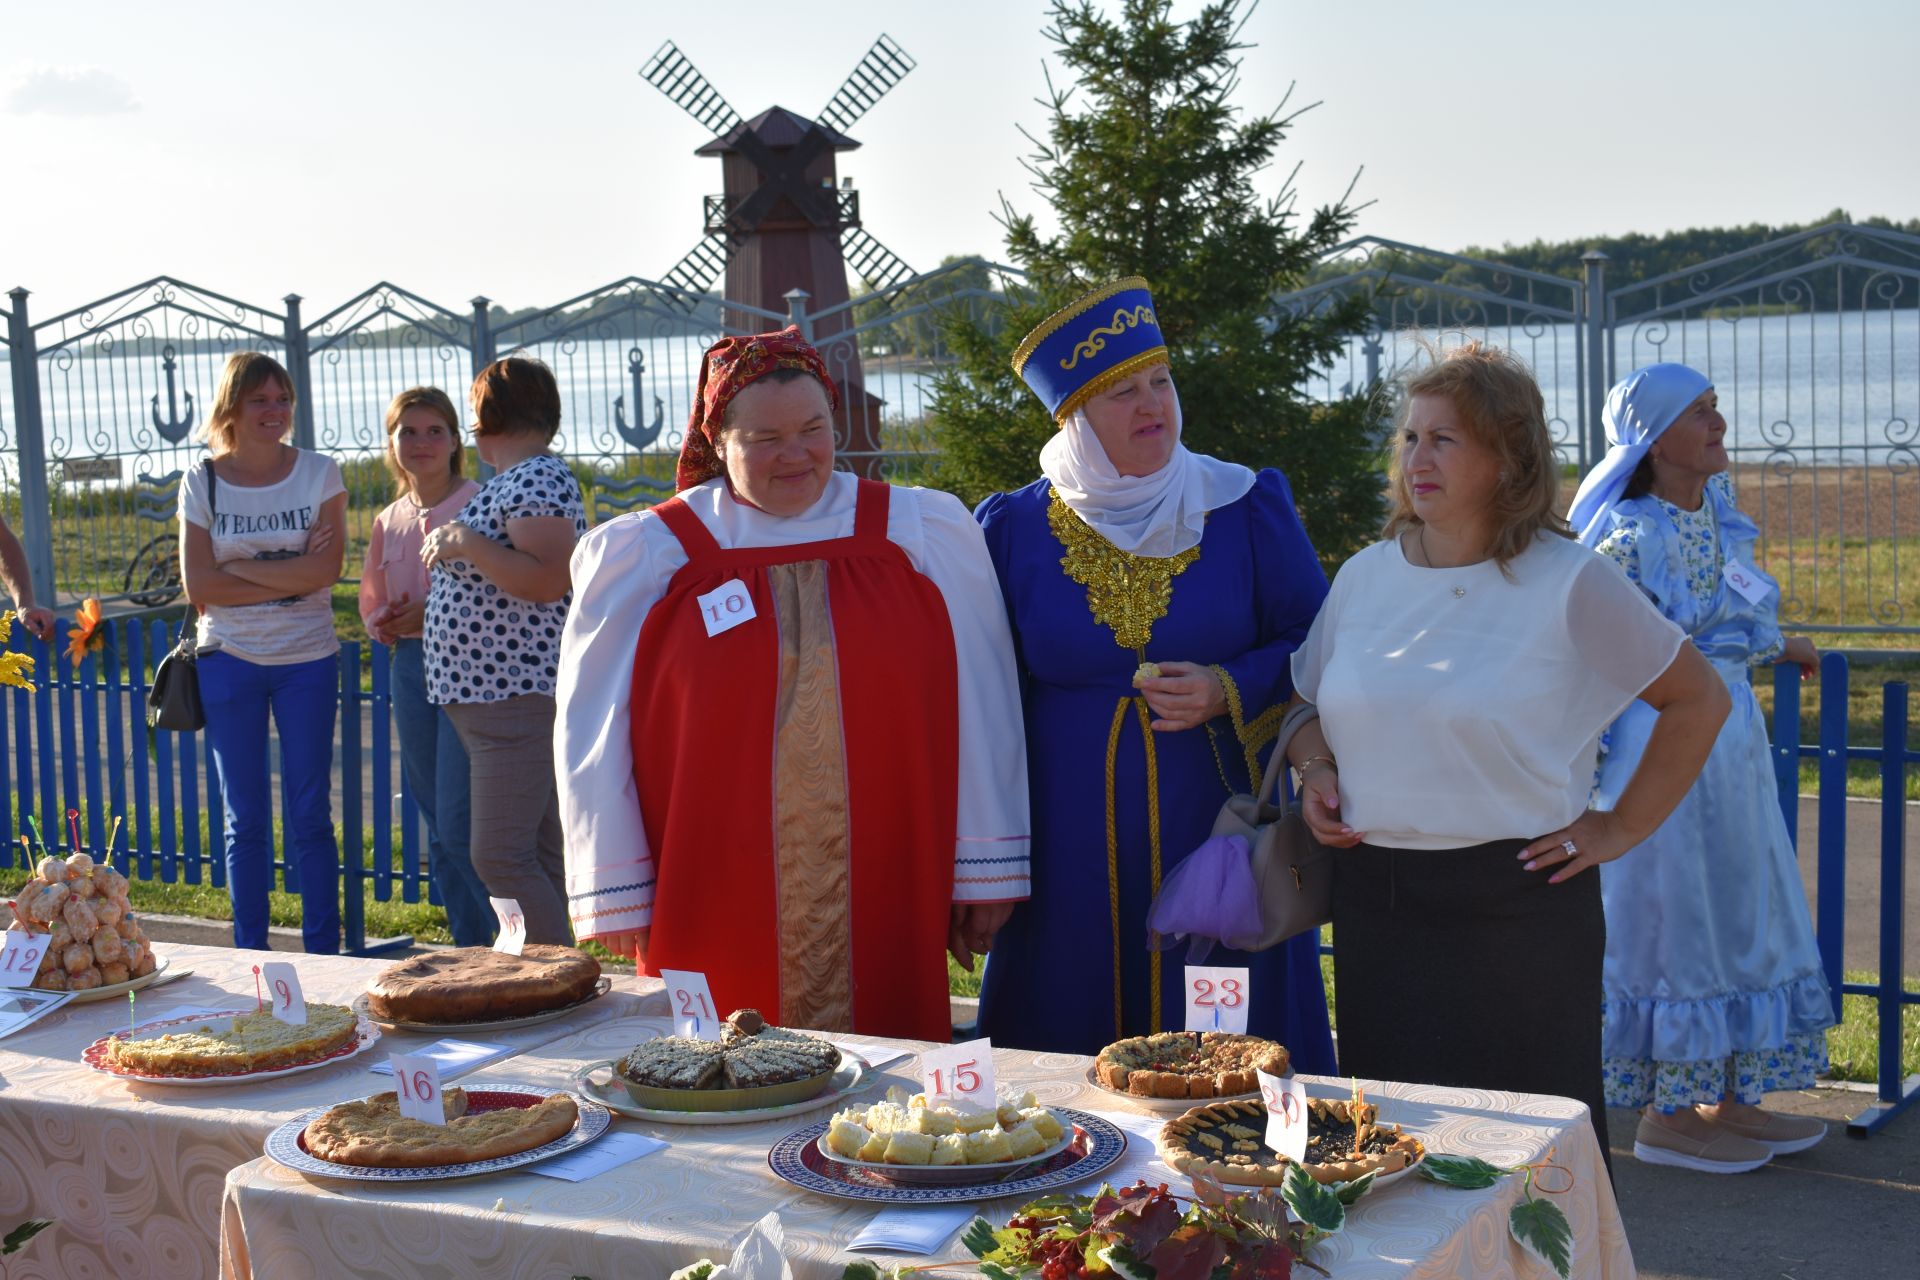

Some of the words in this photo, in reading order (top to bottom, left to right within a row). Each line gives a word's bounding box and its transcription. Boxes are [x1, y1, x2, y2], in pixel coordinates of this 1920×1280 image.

[216, 506, 311, 536] WELCOME
[1731, 573, 1751, 589] 2
[707, 594, 745, 622] 10
[4, 947, 38, 972] 12
[275, 979, 291, 1010] 9
[676, 989, 711, 1019] 21
[1193, 979, 1243, 1008] 23
[397, 1069, 434, 1103] 16
[928, 1058, 982, 1094] 15
